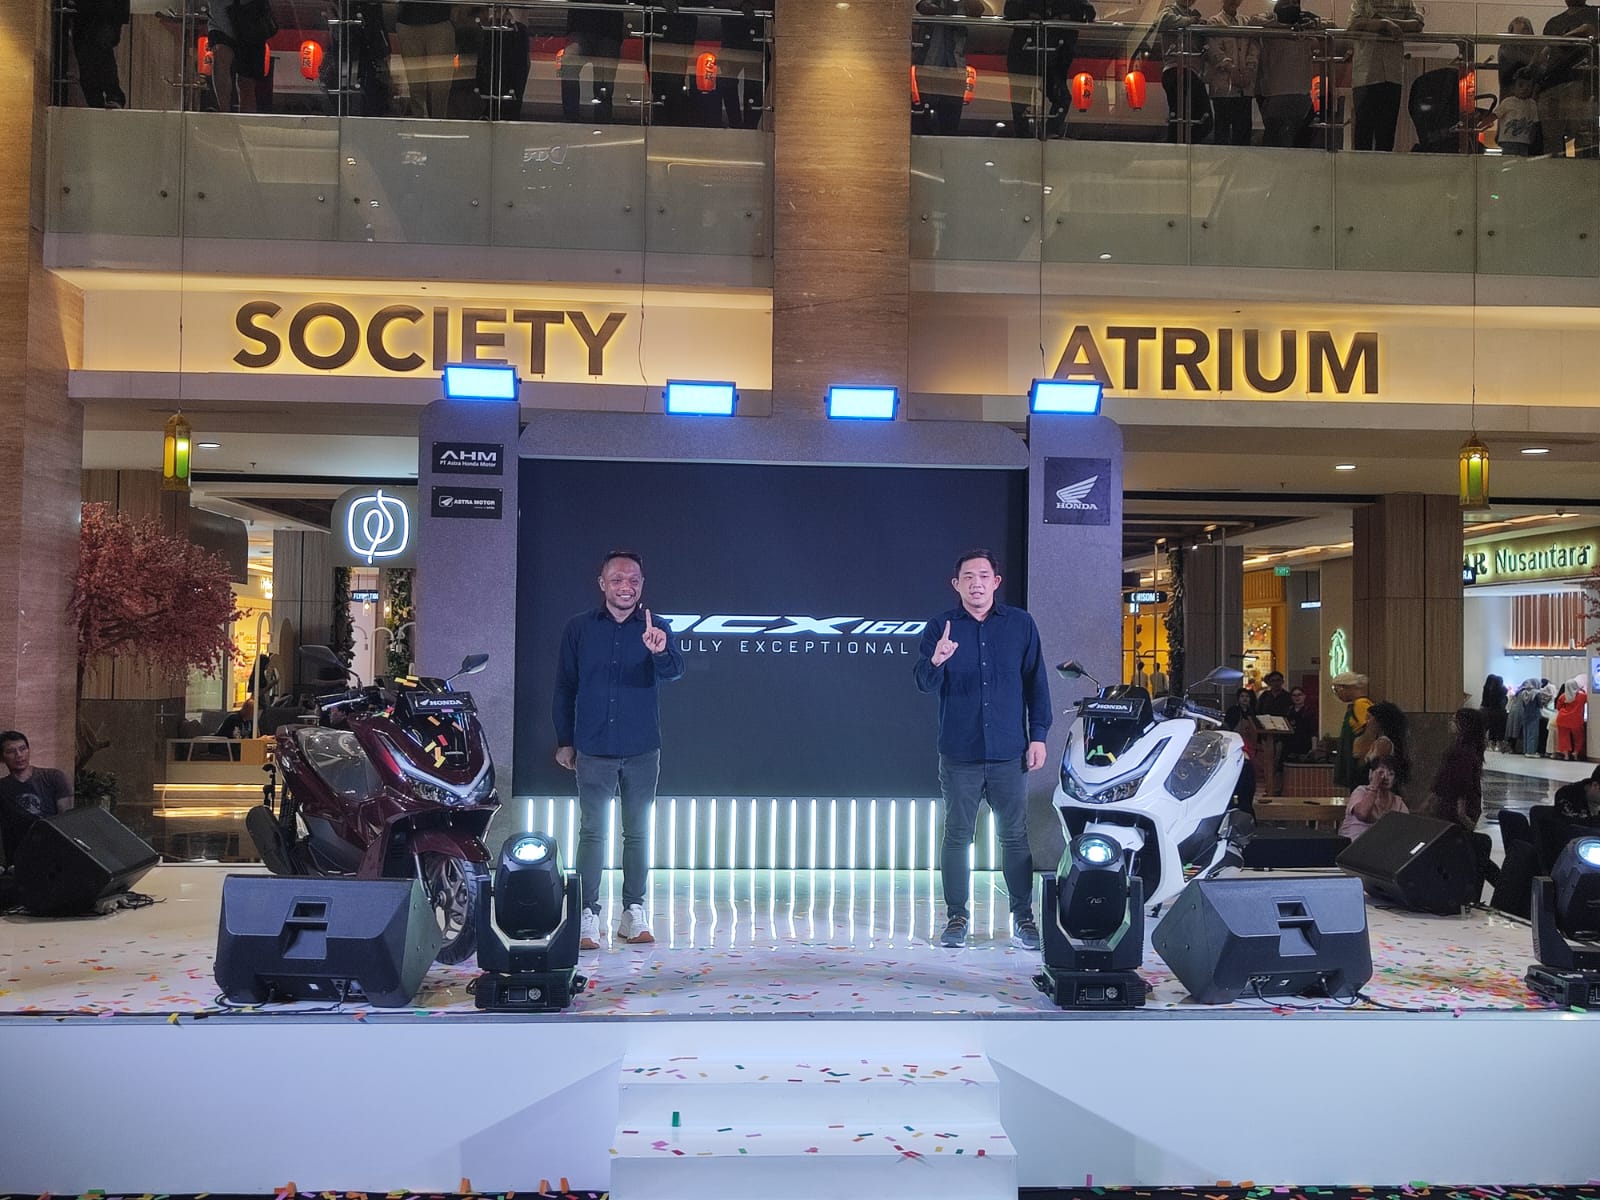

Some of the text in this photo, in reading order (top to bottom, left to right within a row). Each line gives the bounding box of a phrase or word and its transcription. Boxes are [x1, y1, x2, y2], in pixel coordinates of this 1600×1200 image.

[233, 300, 628, 376] SOCIETY
[1052, 325, 1378, 394] ATRIUM
[1056, 502, 1098, 510] HONDA
[1495, 543, 1591, 574] Nusantara
[680, 639, 909, 654] ULY EXCEPTIONAL
